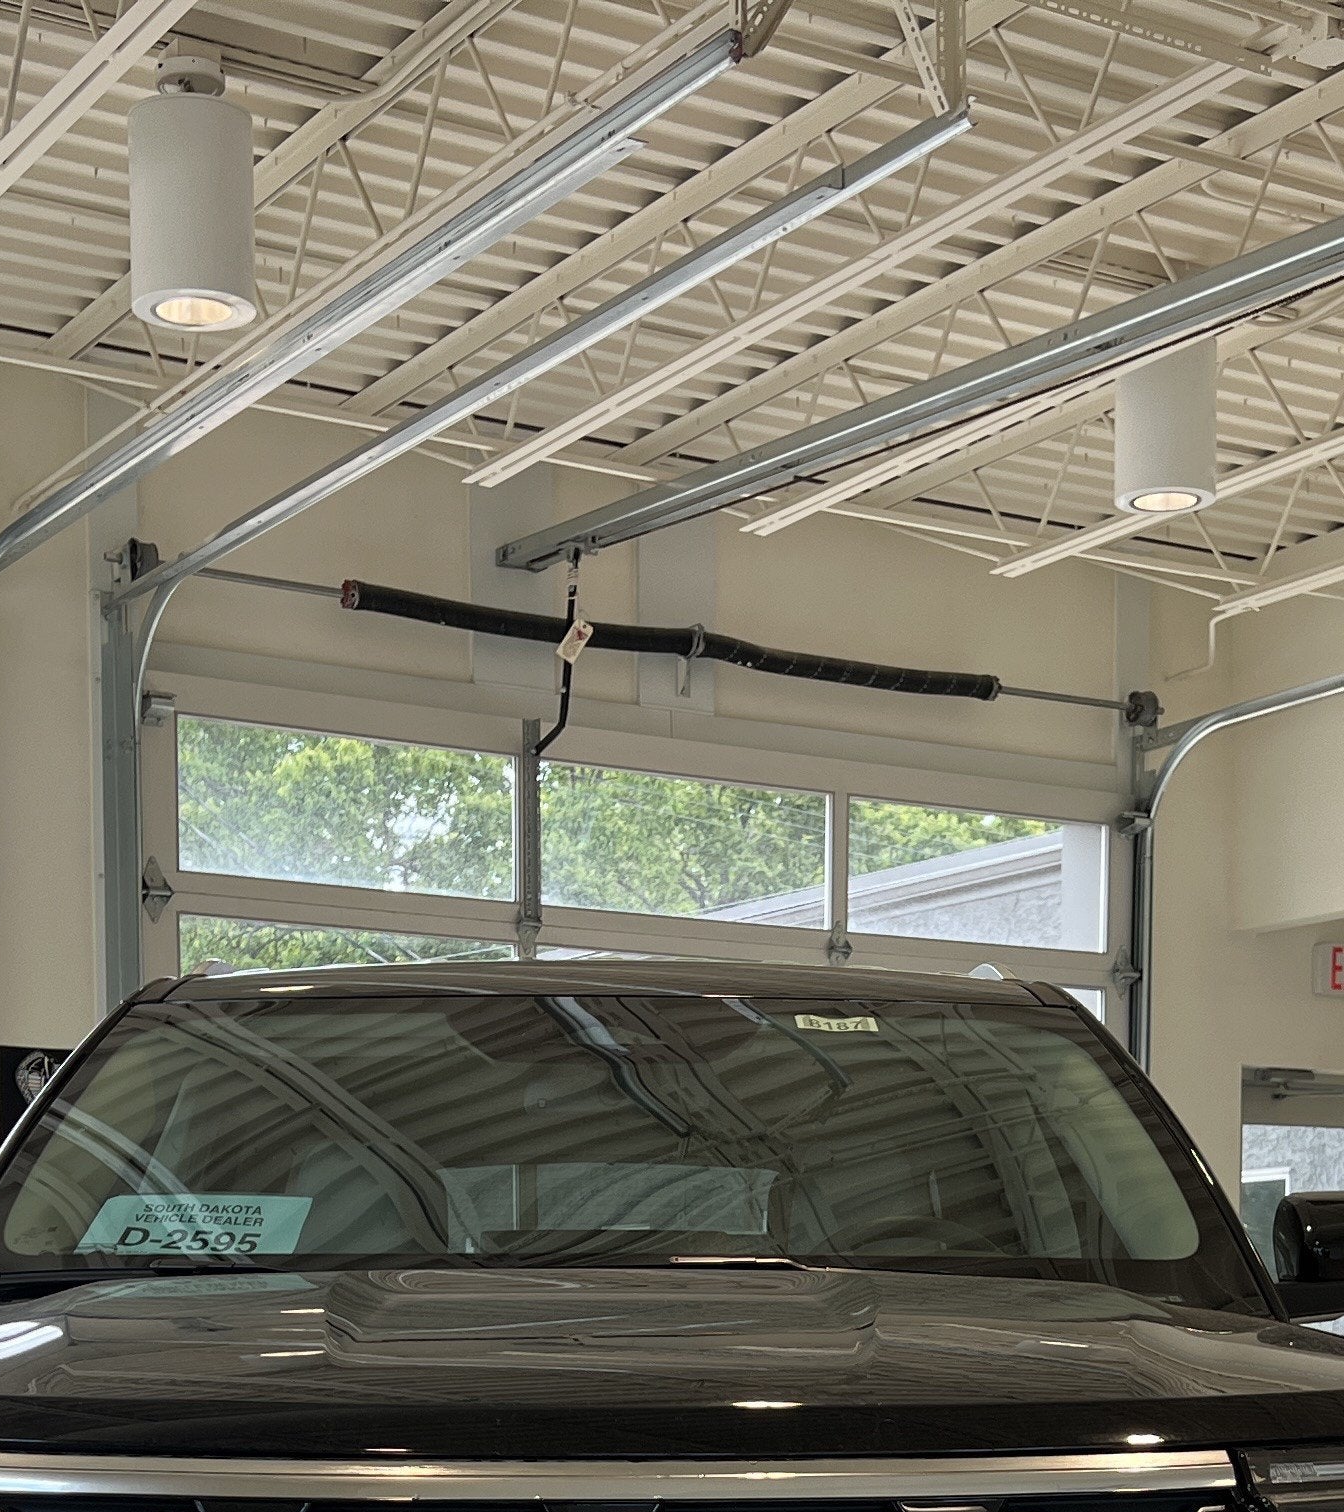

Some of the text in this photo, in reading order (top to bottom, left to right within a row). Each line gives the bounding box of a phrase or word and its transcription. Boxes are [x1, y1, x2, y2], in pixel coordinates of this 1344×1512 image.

[143, 1203, 262, 1215] SOUTH DAKOTA
[135, 1213, 264, 1227] VEHICLE DEALER
[118, 1226, 262, 1253] D-2595
